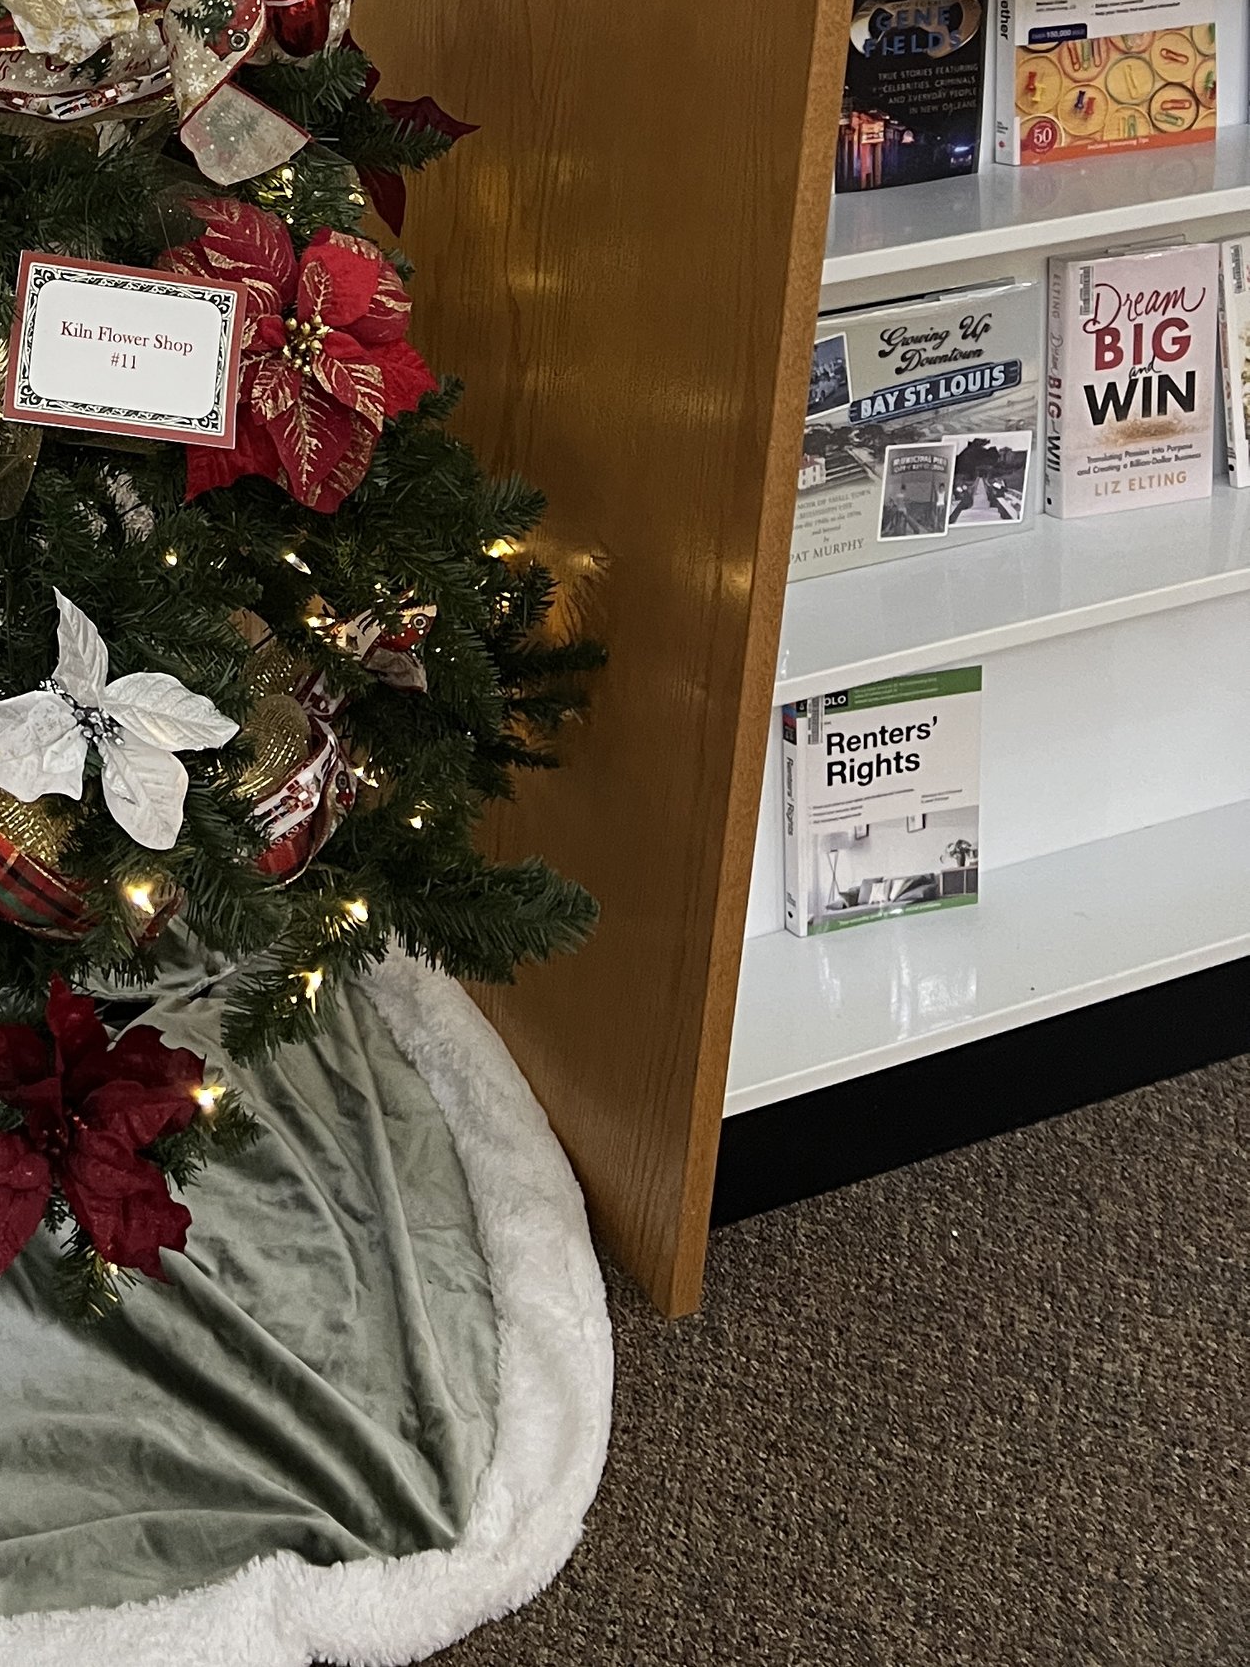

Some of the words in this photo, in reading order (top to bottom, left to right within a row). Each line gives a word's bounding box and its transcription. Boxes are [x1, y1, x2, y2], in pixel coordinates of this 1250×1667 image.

[876, 6, 950, 31] GENE
[863, 30, 962, 58] FIELDS
[901, 68, 932, 79] STORIES
[935, 63, 978, 75] FEATURING
[889, 96, 906, 104] AND
[920, 105, 938, 114] NEW
[1033, 127, 1052, 145] 50
[1050, 273, 1062, 320] ELTING
[1082, 283, 1207, 335] Dream
[61, 321, 93, 340] Kiln
[97, 326, 150, 347] Flower
[153, 334, 194, 356] Shop
[878, 326, 950, 359] Growing
[958, 313, 992, 343] Up
[1094, 317, 1192, 372] BIG
[110, 352, 137, 369] #11
[894, 346, 985, 375] Downtown
[1128, 355, 1162, 379] and
[860, 390, 900, 419] BAY
[904, 383, 934, 408] ST.
[938, 365, 1006, 399] LOUIS
[1047, 375, 1062, 420] BIG
[1083, 370, 1196, 427] WIN
[1077, 466, 1091, 476] and
[1093, 464, 1121, 474] Creating
[1094, 480, 1121, 496] LIZ
[1128, 471, 1187, 491] ELTING
[813, 537, 865, 559] MURPHY
[824, 695, 847, 707] OLO
[827, 751, 920, 787] Rights
